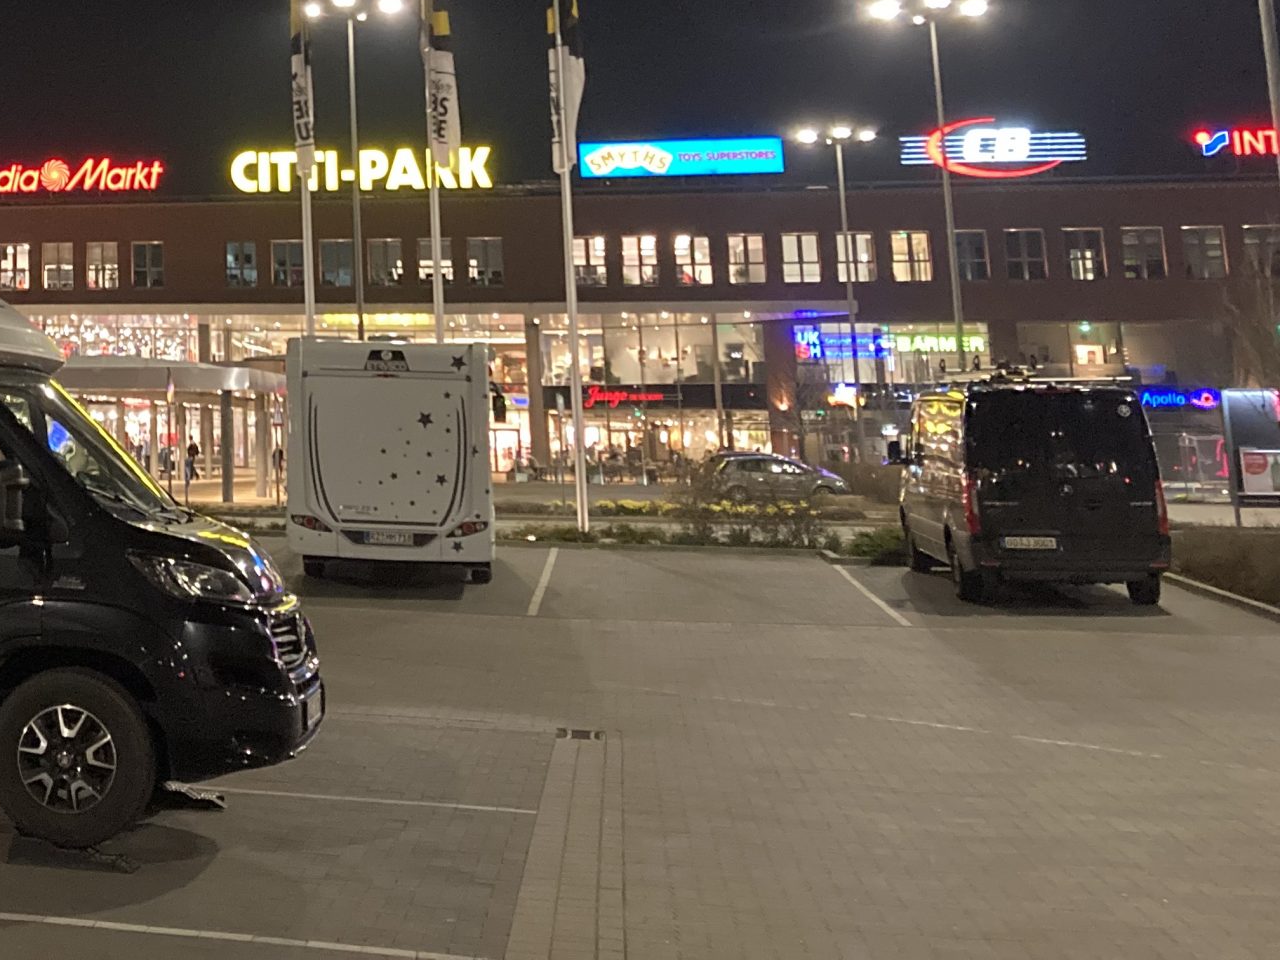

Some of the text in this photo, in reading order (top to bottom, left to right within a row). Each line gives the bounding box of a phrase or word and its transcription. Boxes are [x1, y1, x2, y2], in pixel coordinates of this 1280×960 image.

[589, 149, 668, 171] SMYTHS
[677, 150, 777, 162] TOYS SUPERSTORES
[896, 335, 985, 352] BARMER
[1142, 392, 1186, 407] Apollo
